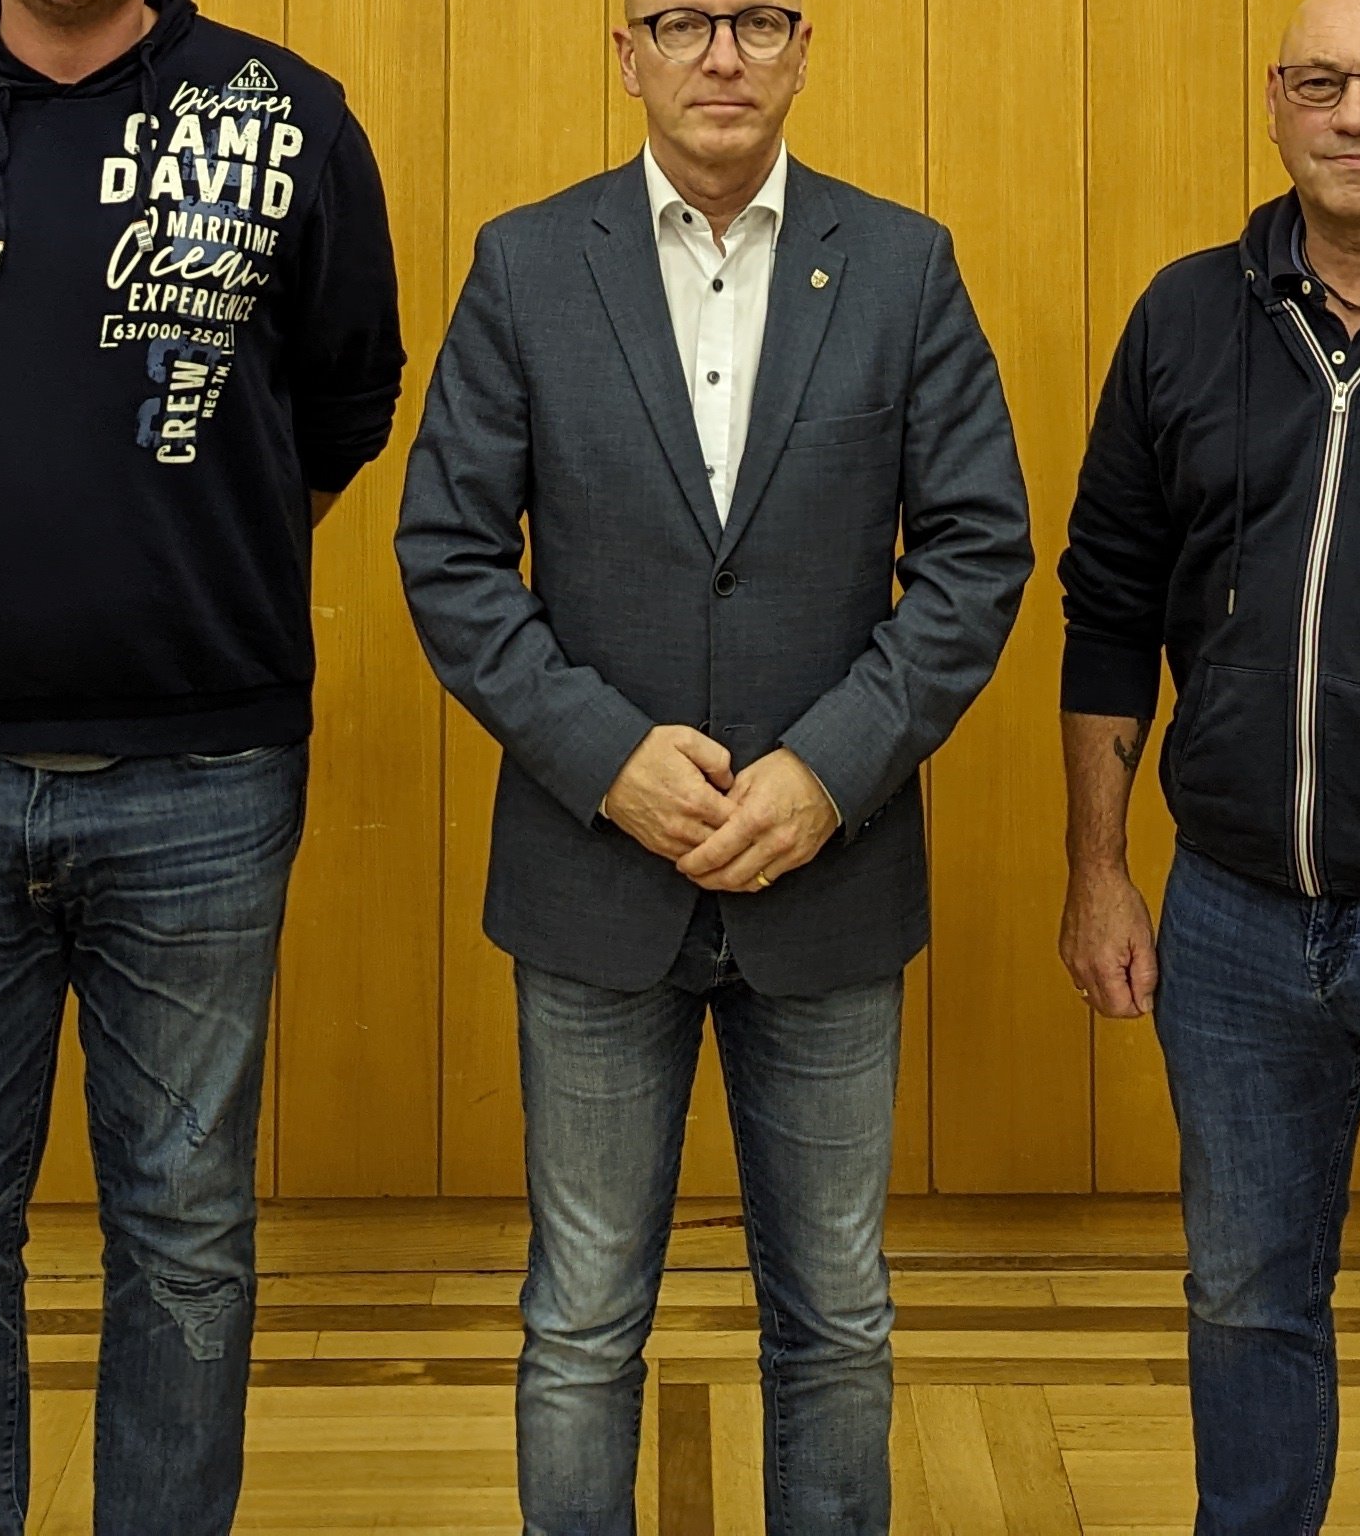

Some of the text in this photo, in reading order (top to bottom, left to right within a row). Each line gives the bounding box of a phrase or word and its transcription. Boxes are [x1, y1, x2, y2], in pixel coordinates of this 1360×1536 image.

[249, 62, 260, 78] C
[169, 80, 292, 120] Discover
[124, 113, 304, 168] CAMP
[100, 156, 294, 219] DAVID
[106, 206, 270, 290] Ocean
[166, 210, 280, 257] MARITIME
[127, 282, 257, 322] EXPERIENCE
[156, 360, 209, 464] CREW
